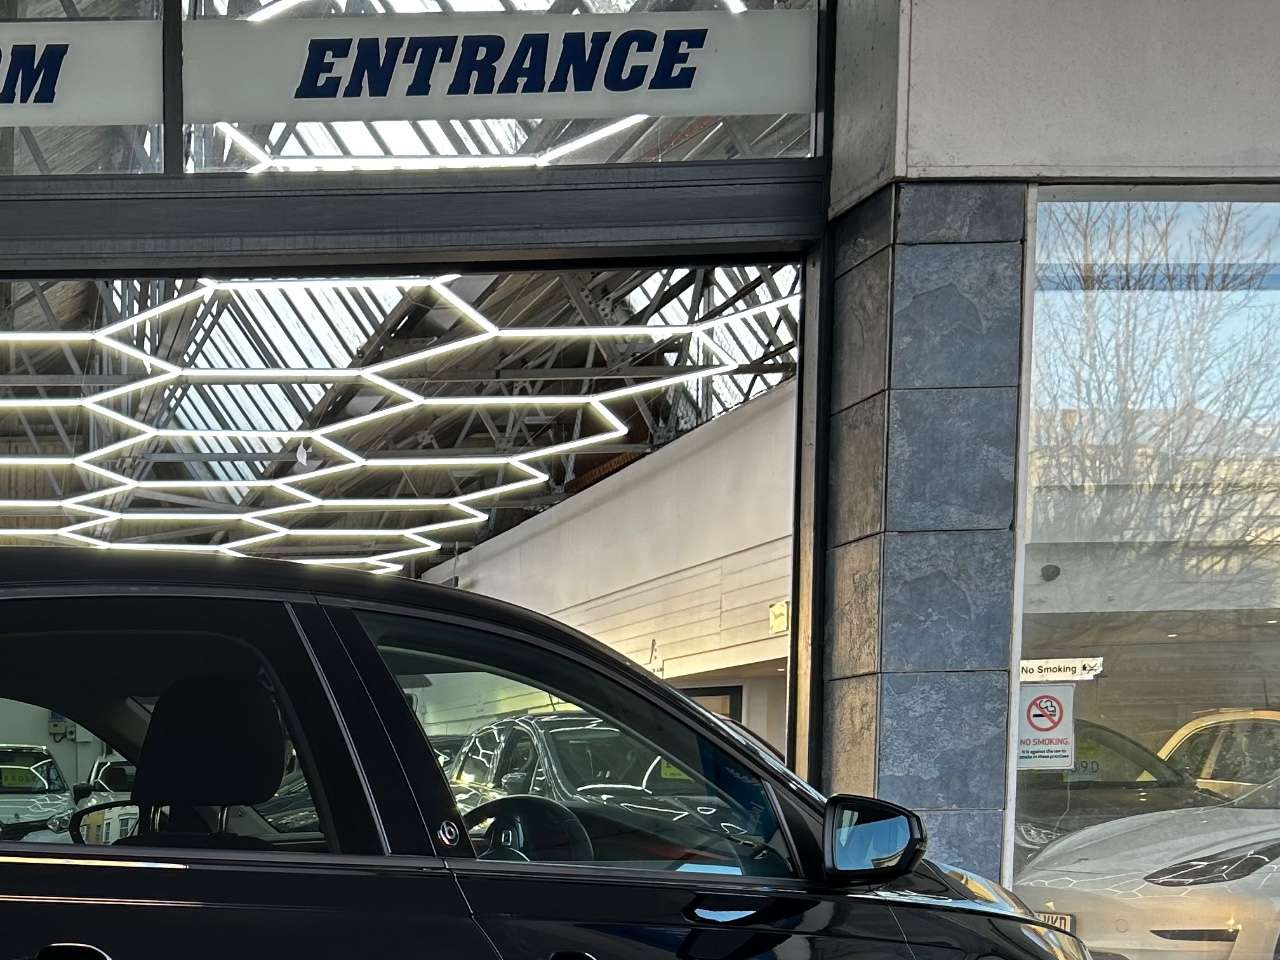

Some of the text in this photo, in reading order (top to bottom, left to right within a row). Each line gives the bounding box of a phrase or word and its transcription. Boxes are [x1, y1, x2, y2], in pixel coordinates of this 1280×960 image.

[293, 28, 709, 99] ENTRANCE
[1021, 665, 1077, 675] No Smoking
